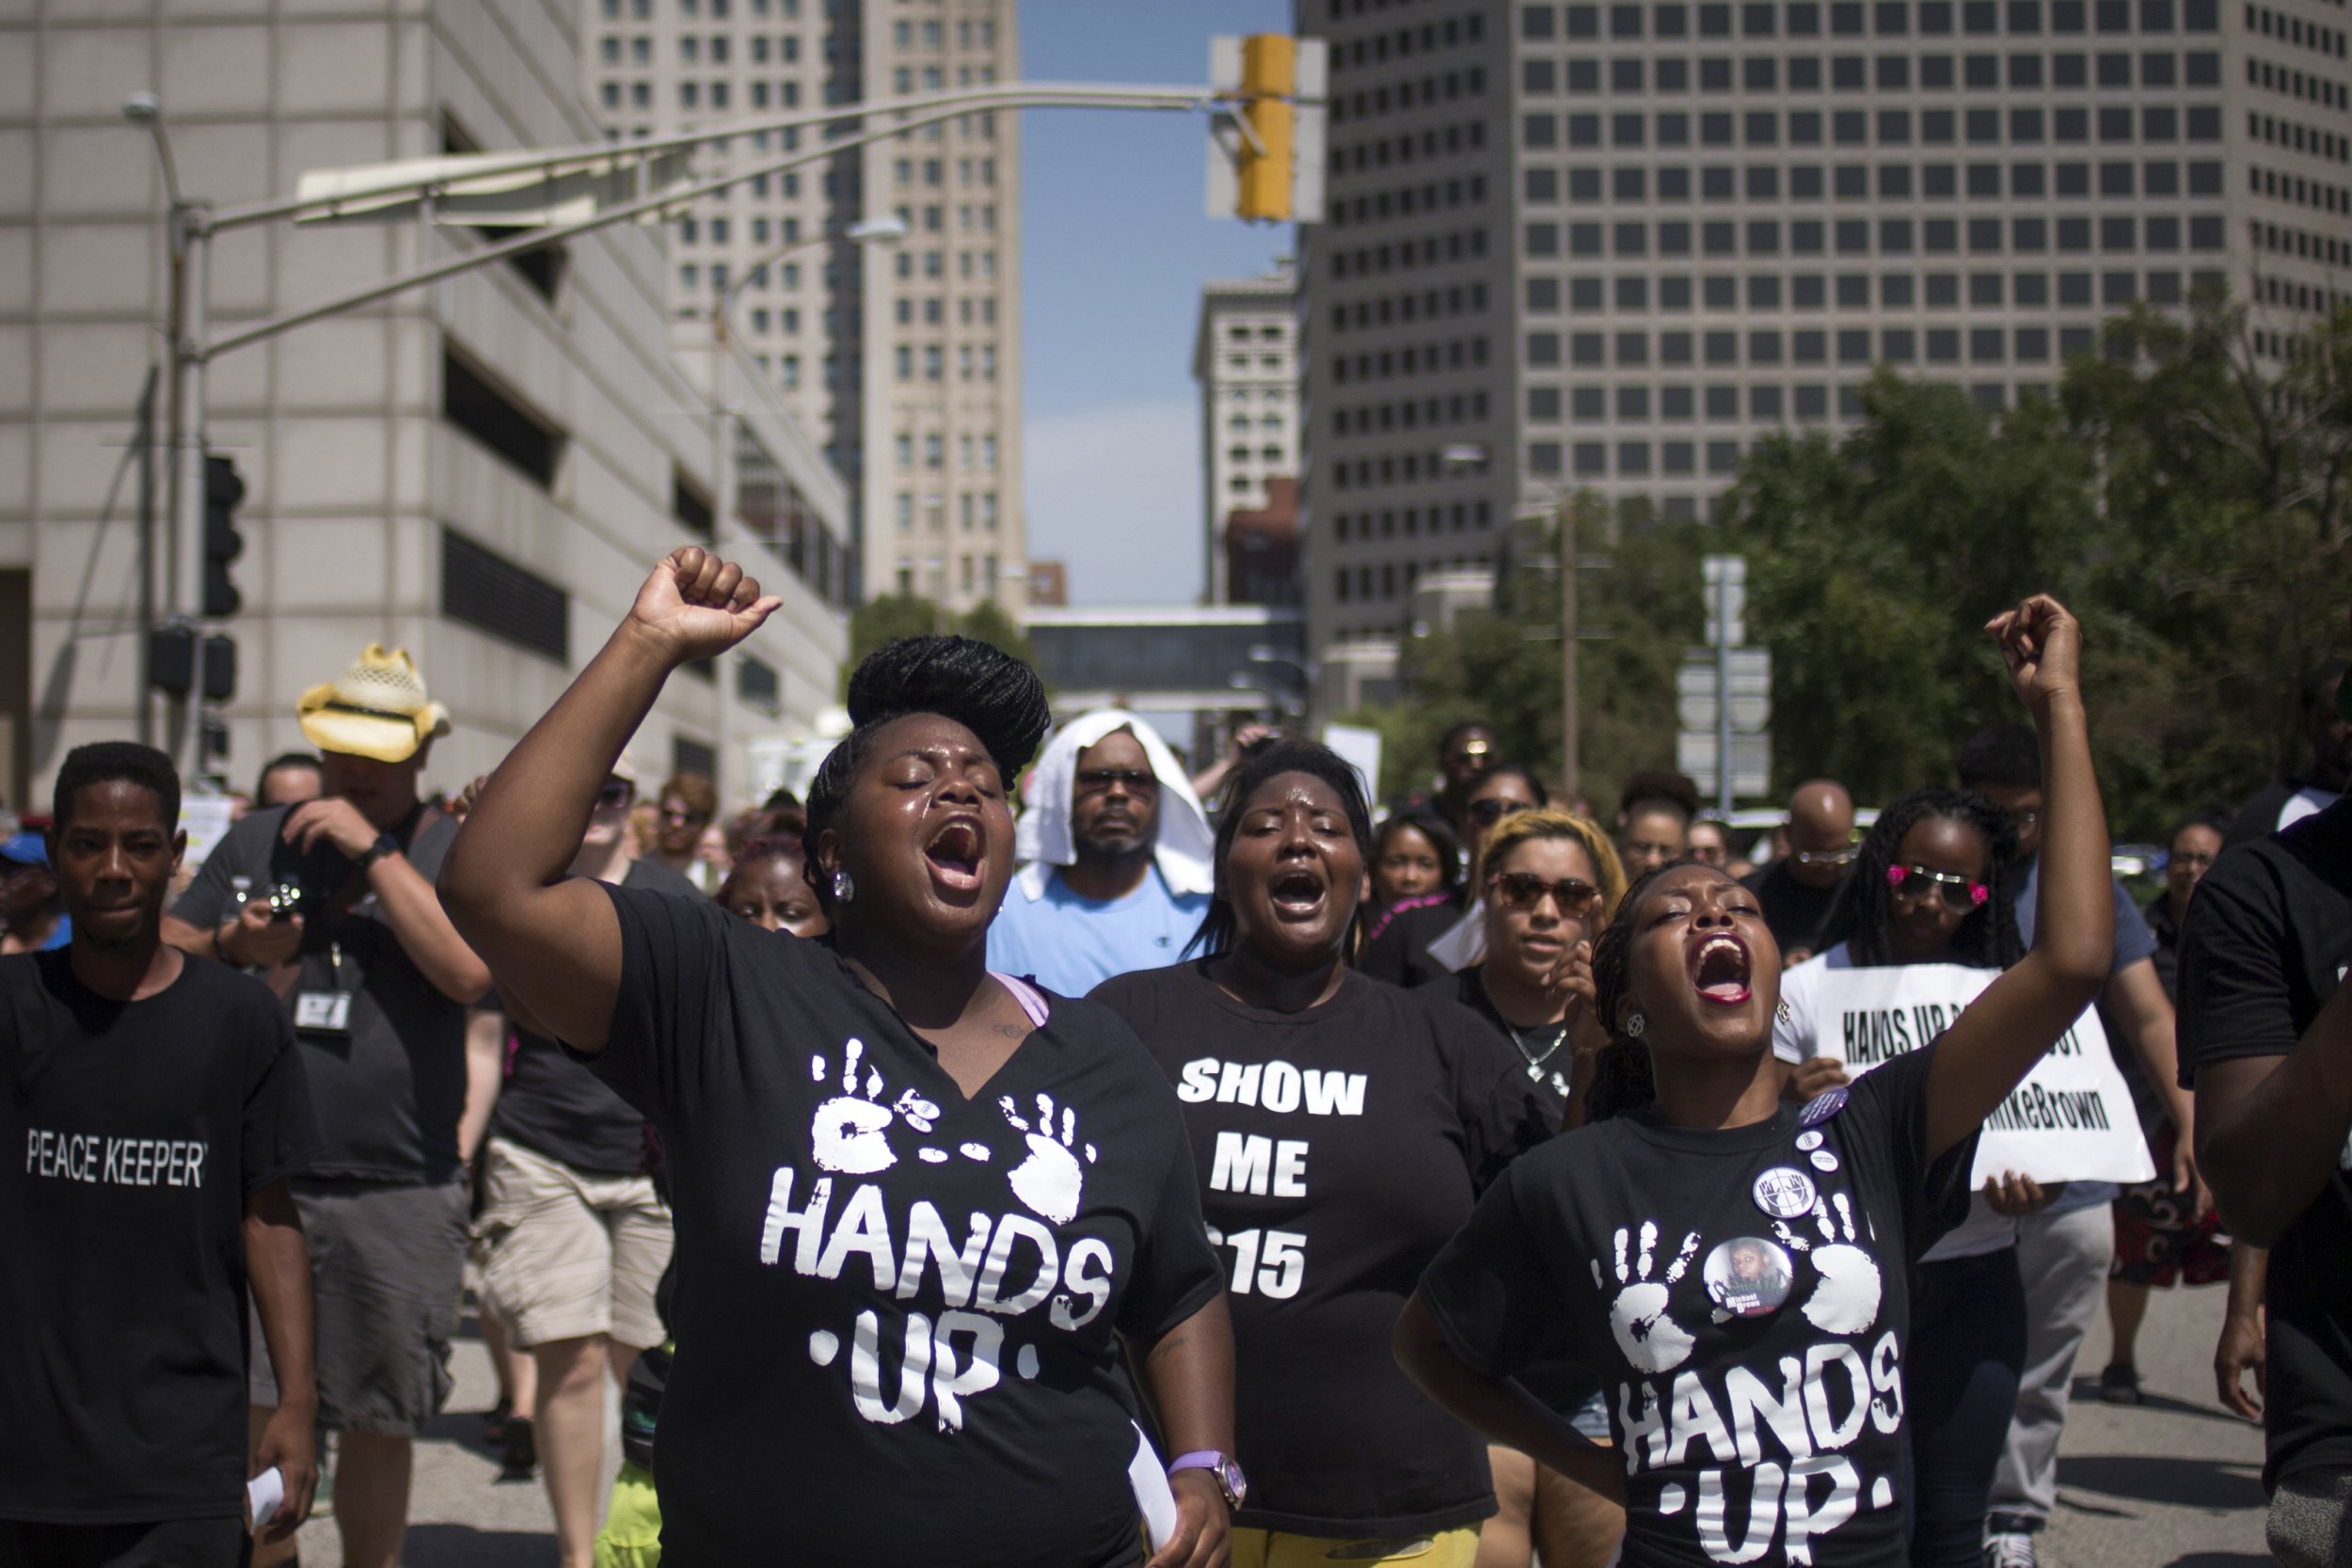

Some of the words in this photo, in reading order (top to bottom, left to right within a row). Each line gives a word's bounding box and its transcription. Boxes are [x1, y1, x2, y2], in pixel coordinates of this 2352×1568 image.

[1843, 1007, 1912, 1064] HANDS
[1177, 1057, 1367, 1116] SHOW
[26, 1128, 100, 1183] PEACE
[1210, 1132, 1309, 1197] ME
[760, 1166, 1113, 1331] HANDS
[1203, 1221, 1308, 1299] 15
[851, 1309, 1005, 1434] UP
[1618, 1330, 1904, 1476] HANDS
[1696, 1454, 1861, 1568] UP
